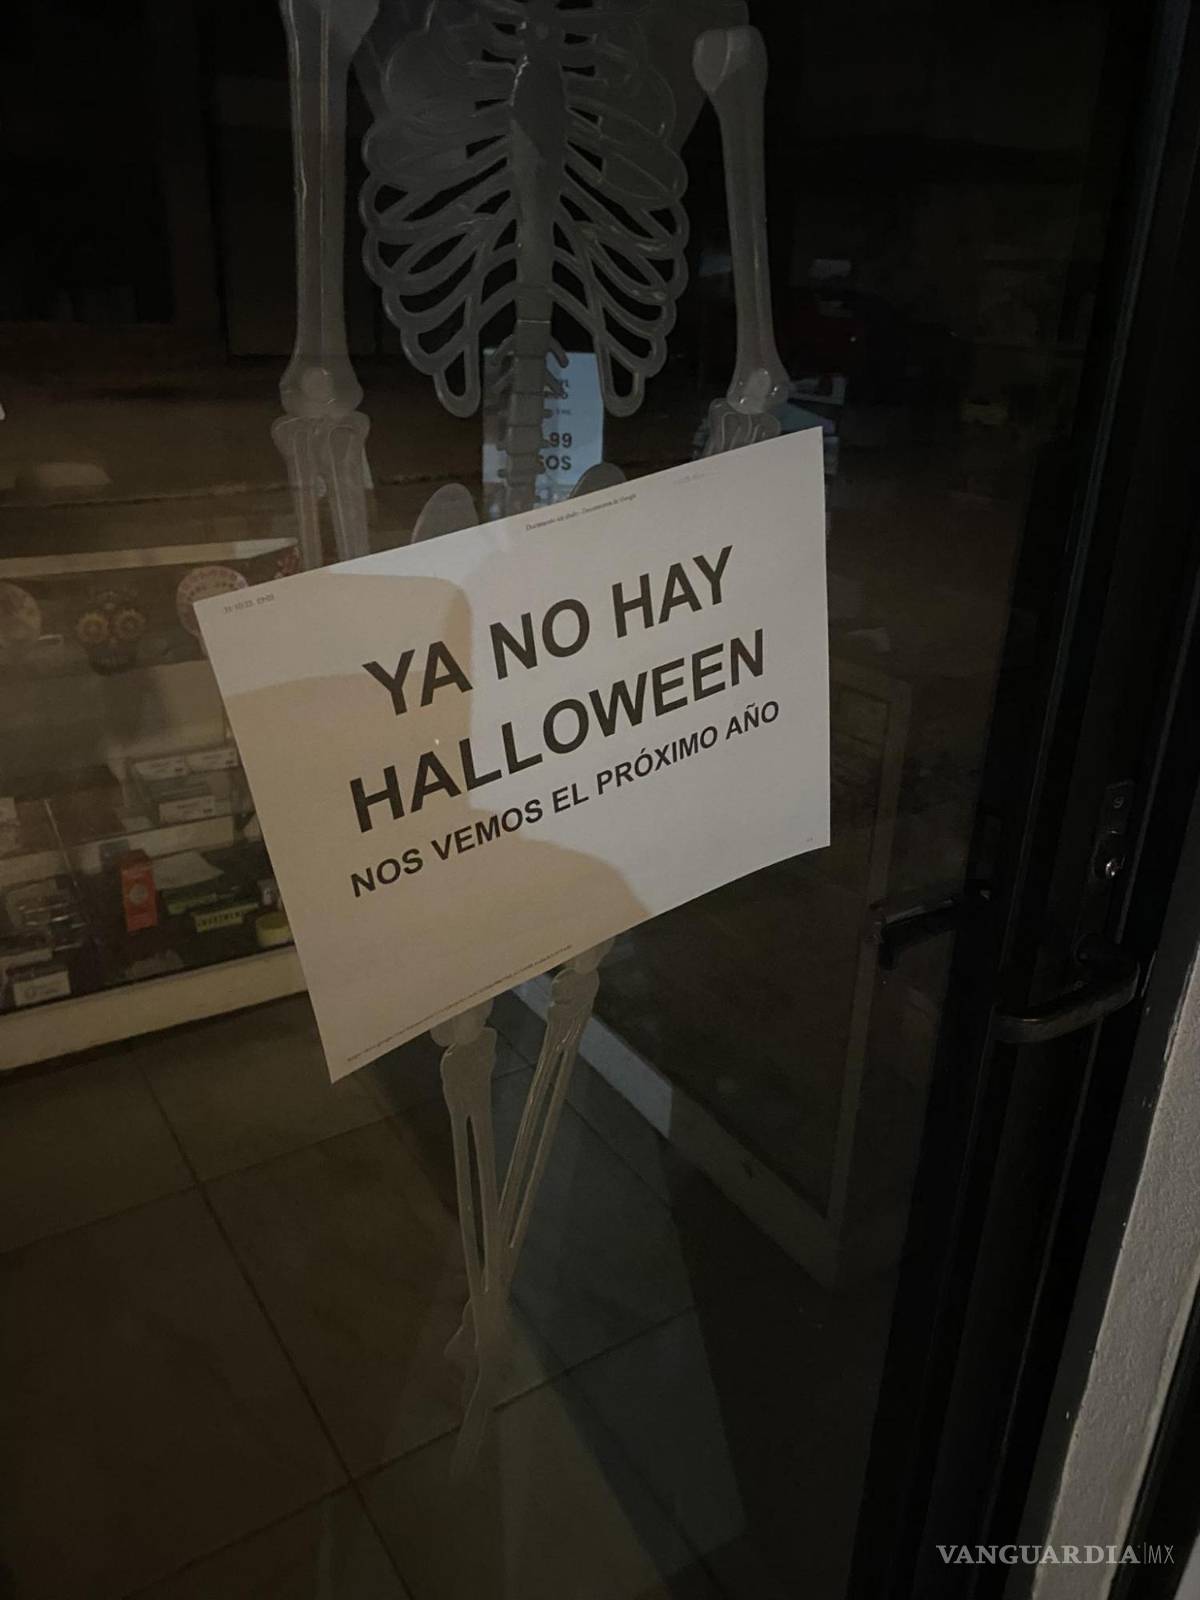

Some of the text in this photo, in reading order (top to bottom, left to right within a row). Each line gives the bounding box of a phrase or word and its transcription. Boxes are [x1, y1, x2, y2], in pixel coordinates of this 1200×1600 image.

[362, 545, 733, 716] YA NO HAY
[350, 628, 764, 833] HALLOWEEN
[351, 700, 780, 898] NOS VEMOS EL PRÓXIMO AÑO
